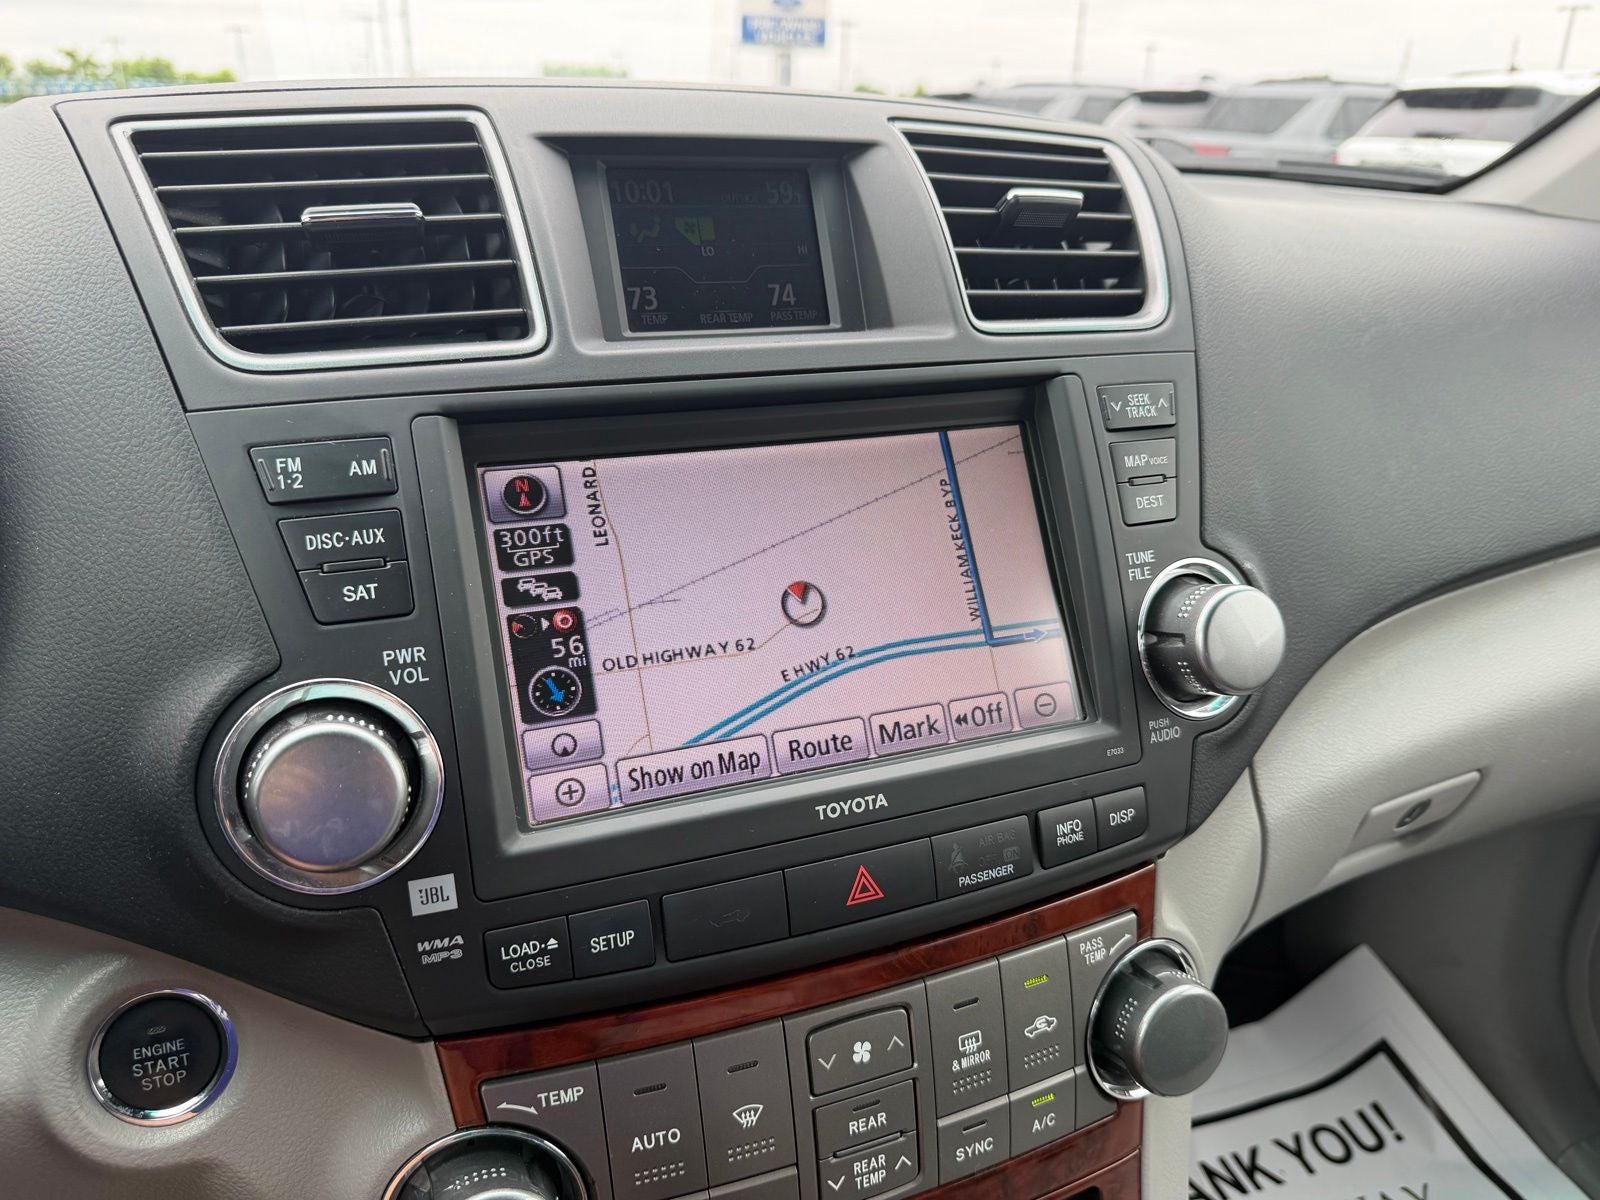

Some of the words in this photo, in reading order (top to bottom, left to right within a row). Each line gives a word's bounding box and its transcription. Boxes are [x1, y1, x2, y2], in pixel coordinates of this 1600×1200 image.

[610, 180, 674, 204] 10:01
[627, 286, 658, 311] 73
[767, 283, 797, 307] 74
[641, 313, 668, 325] TEMP
[700, 312, 727, 324] REAR
[728, 311, 753, 323] TEMP
[770, 311, 793, 321] PASS
[794, 309, 818, 320] TEMP
[1127, 393, 1151, 406] SEEK
[1125, 405, 1157, 418] TRACK
[276, 456, 302, 473] FM
[349, 459, 378, 476] AM
[1124, 454, 1148, 468] MAP
[1149, 456, 1169, 465] VOICE
[514, 479, 530, 493] N
[582, 466, 609, 547] LEONARD
[1135, 495, 1164, 509] DEST
[500, 527, 564, 548] 300ft
[513, 549, 554, 567] GPS
[1125, 550, 1155, 566] TUNE
[1128, 567, 1152, 581] FILE
[342, 583, 378, 602] SAT
[382, 646, 427, 666] PWR
[551, 635, 585, 658] 56
[602, 655, 638, 672] OLD
[642, 641, 729, 666] HIGHWAY
[735, 638, 756, 652] 62
[568, 655, 588, 669] mi
[780, 670, 790, 683] E
[794, 654, 830, 677] HWY
[836, 645, 856, 661] 62
[389, 667, 430, 686] VOL
[971, 701, 1004, 727] Off
[1148, 718, 1170, 730] PUSH
[878, 714, 943, 745] Mark
[1150, 726, 1181, 744] AUDIO
[788, 732, 853, 762] Route
[1106, 746, 1125, 757] E7033
[628, 765, 684, 793] Show
[691, 759, 715, 779] on
[717, 751, 761, 777] Map
[815, 793, 889, 820] TOYOTA
[1109, 808, 1135, 826] DISP
[1056, 819, 1082, 836] INFO
[1056, 831, 1084, 847] PHONE
[958, 863, 1015, 888] PASSENGER
[416, 935, 465, 952] WMA
[590, 930, 635, 953] SETUP
[1079, 936, 1104, 955] PASS
[421, 948, 464, 965] MP3
[510, 955, 552, 973] CLOSE
[1084, 947, 1107, 966] TEMP
[132, 1038, 186, 1060] ENGINE
[132, 1053, 191, 1077] START
[952, 1060, 961, 1072] &
[961, 1049, 992, 1071] MIRROR
[141, 1070, 187, 1091] STOP
[537, 1086, 584, 1108] TEMP
[849, 1112, 888, 1136] REAR
[1031, 1113, 1056, 1133] A/C
[631, 1128, 681, 1153] AUTO
[1272, 1101, 1405, 1175] YOU!
[956, 1137, 994, 1162] SYNC
[853, 1153, 887, 1174] REAR
[854, 1169, 887, 1191] TEMP
